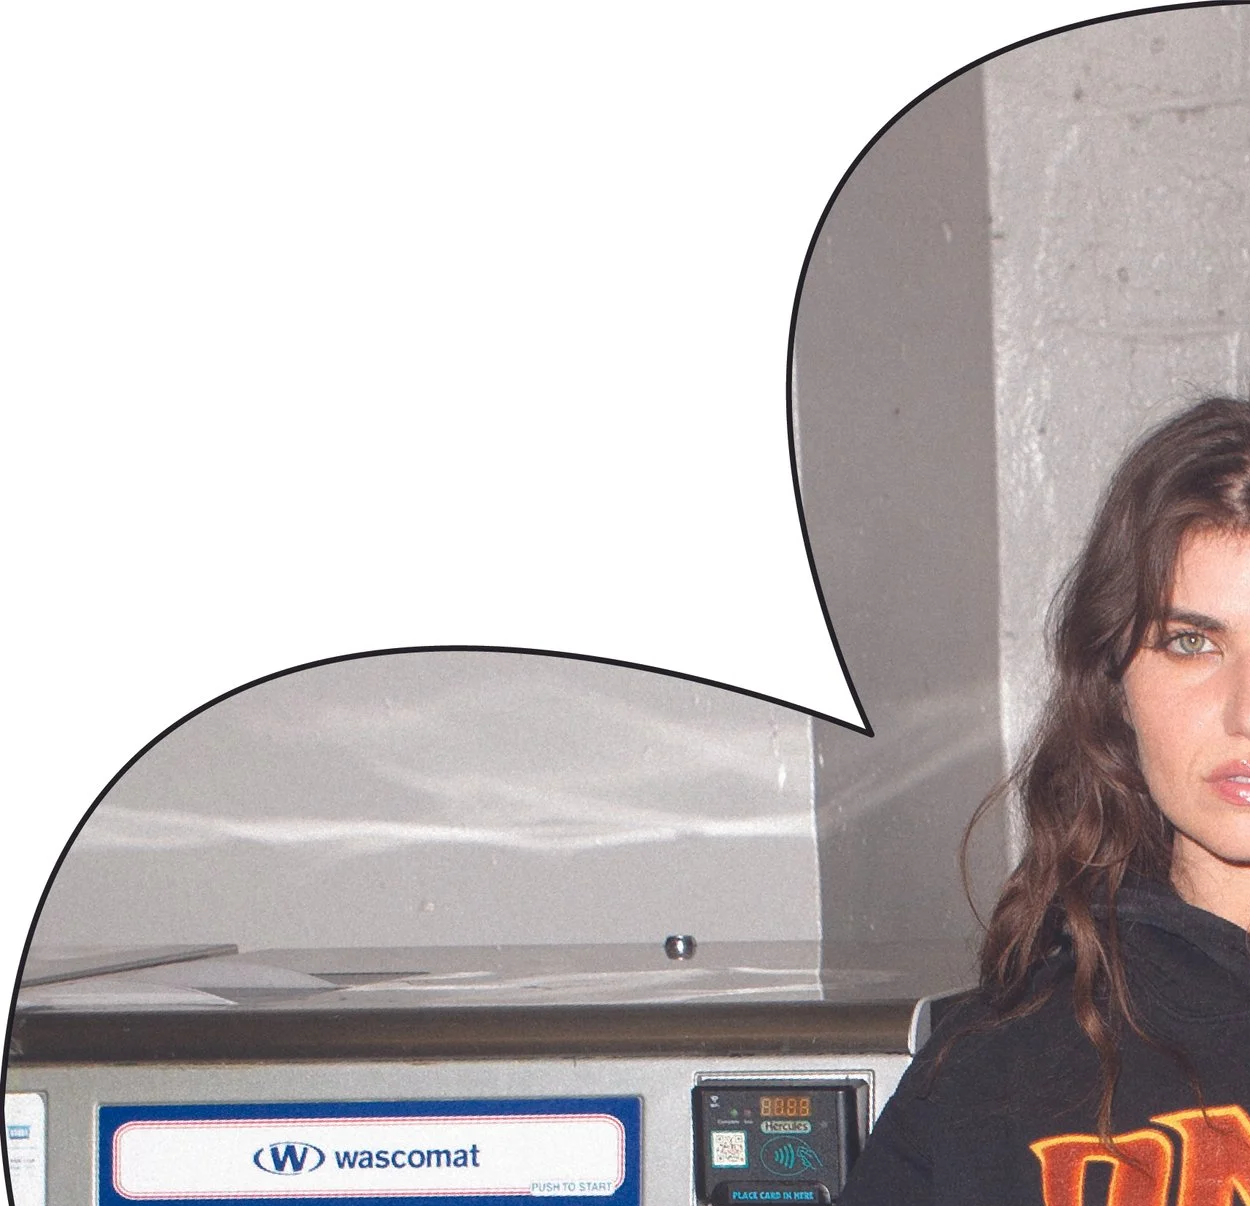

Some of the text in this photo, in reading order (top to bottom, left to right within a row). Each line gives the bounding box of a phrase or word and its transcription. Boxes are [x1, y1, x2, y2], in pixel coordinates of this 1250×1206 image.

[765, 1121, 809, 1131] Hercules
[269, 1143, 481, 1173] W wascomat
[531, 1181, 613, 1192] PUSH TO START
[732, 1191, 814, 1200] PLACE CARD IN HERE
